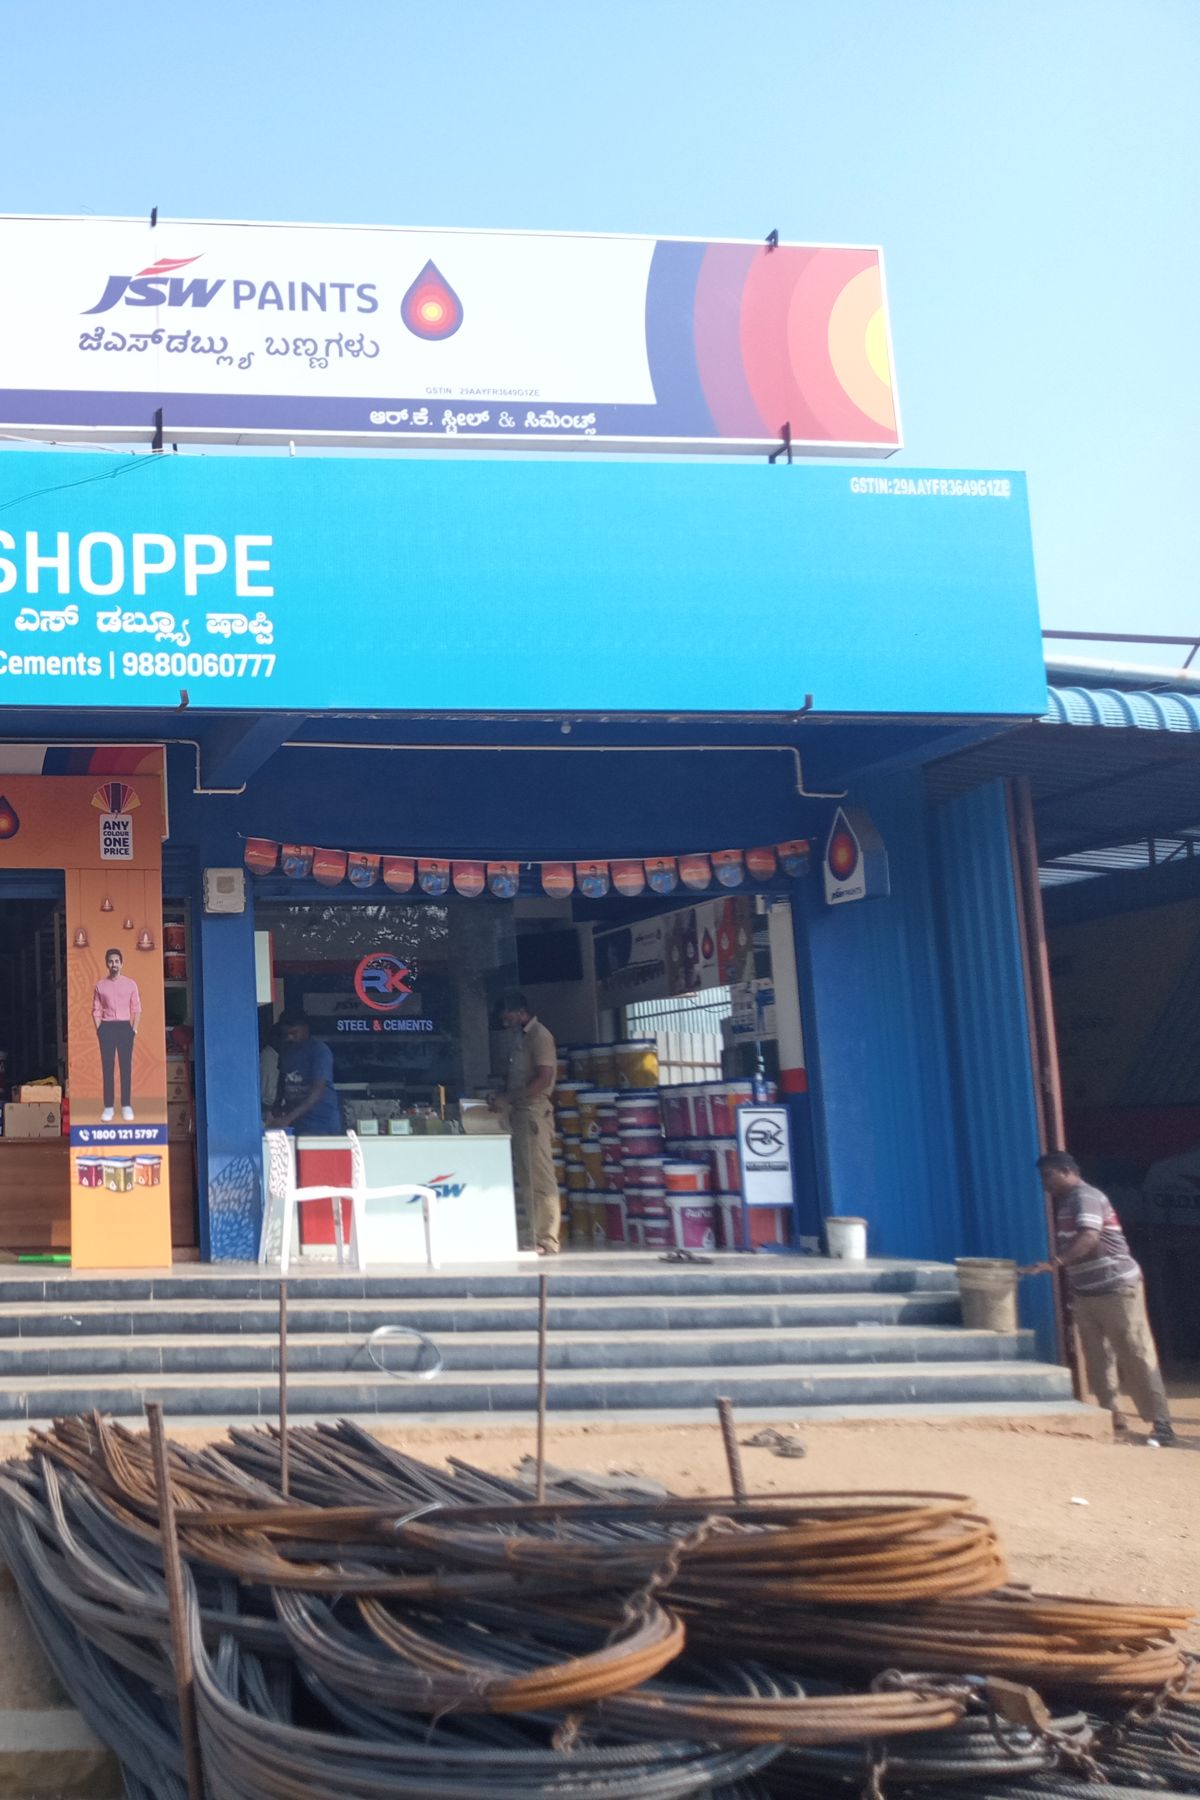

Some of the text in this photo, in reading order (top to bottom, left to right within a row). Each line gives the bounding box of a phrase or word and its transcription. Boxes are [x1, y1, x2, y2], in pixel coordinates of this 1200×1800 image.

[79, 274, 380, 315] JSW PAINTS
[264, 331, 381, 370] ಬಣ್ಣಗಳು
[498, 411, 516, 428] &
[14, 603, 80, 633] ಎಸ್
[122, 651, 277, 679] 9880060777
[103, 820, 129, 831] ANY
[103, 837, 130, 848] ONE
[103, 847, 130, 856] PRICE
[337, 1019, 433, 1032] STEEL & CEMENTS
[91, 1128, 159, 1140] 1800 121 5797
